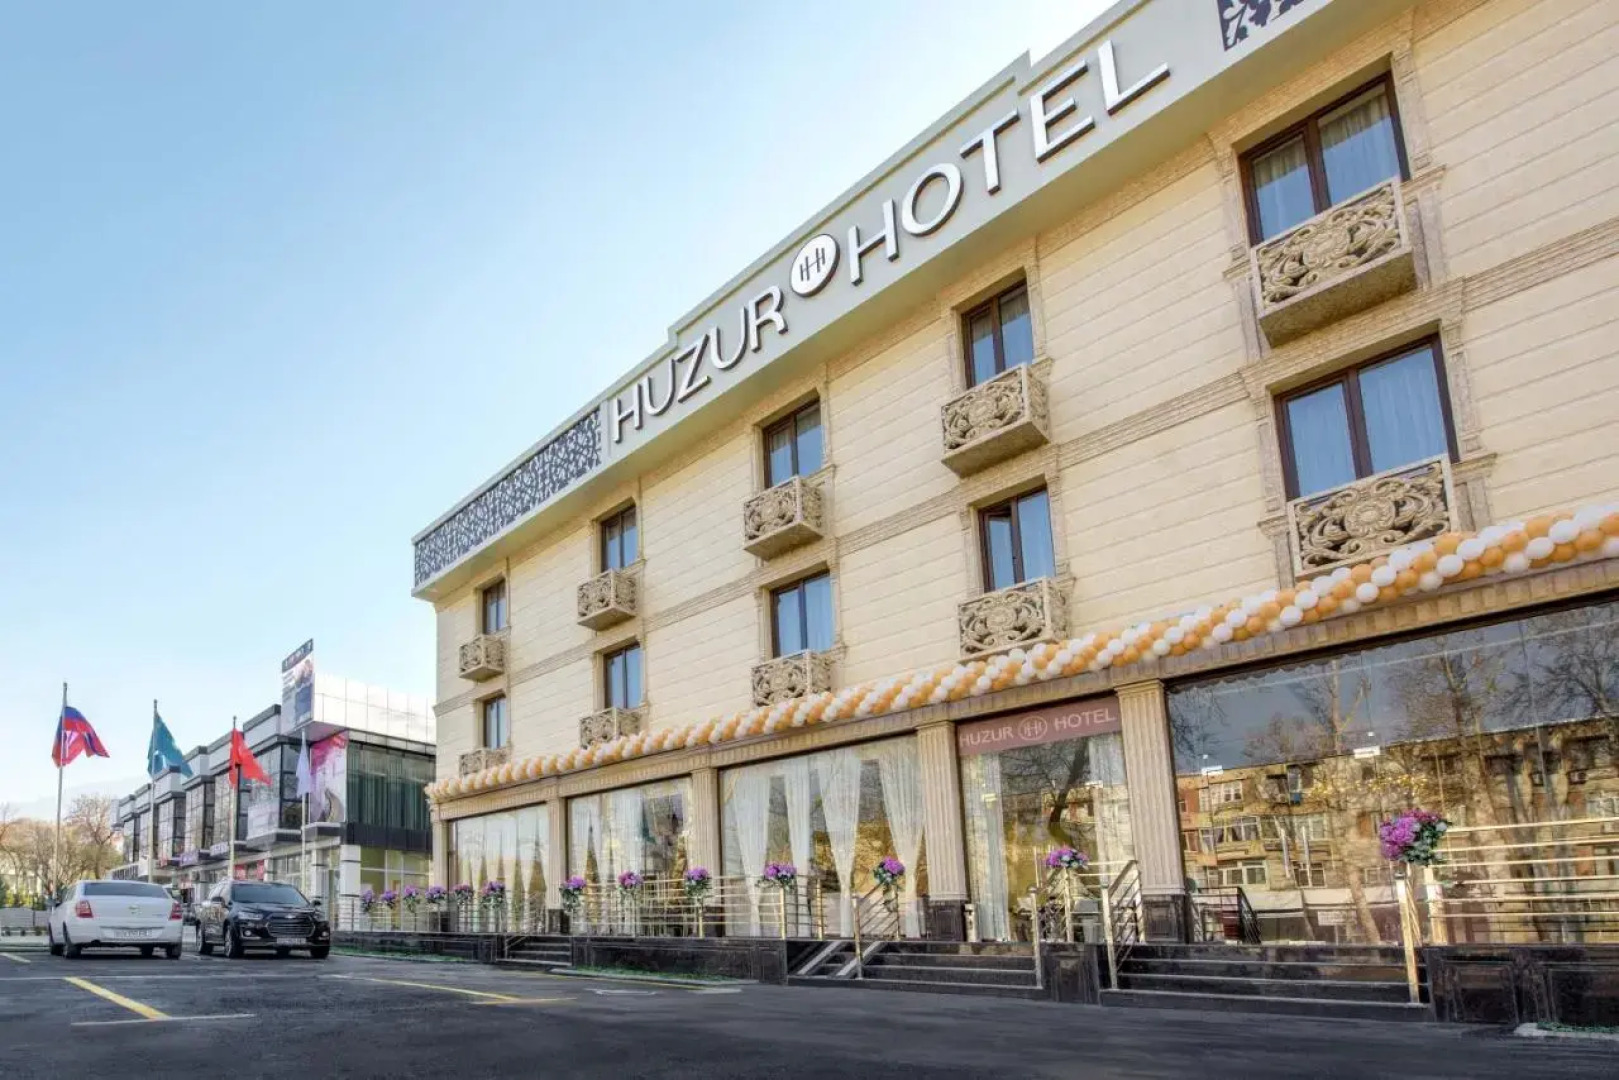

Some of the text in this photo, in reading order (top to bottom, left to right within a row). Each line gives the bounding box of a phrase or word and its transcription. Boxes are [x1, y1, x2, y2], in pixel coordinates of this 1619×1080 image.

[612, 284, 788, 444] HUZUR
[848, 40, 1170, 286] HOTEL
[959, 726, 1014, 747] HUZUR
[1054, 708, 1117, 731] HOTEL
